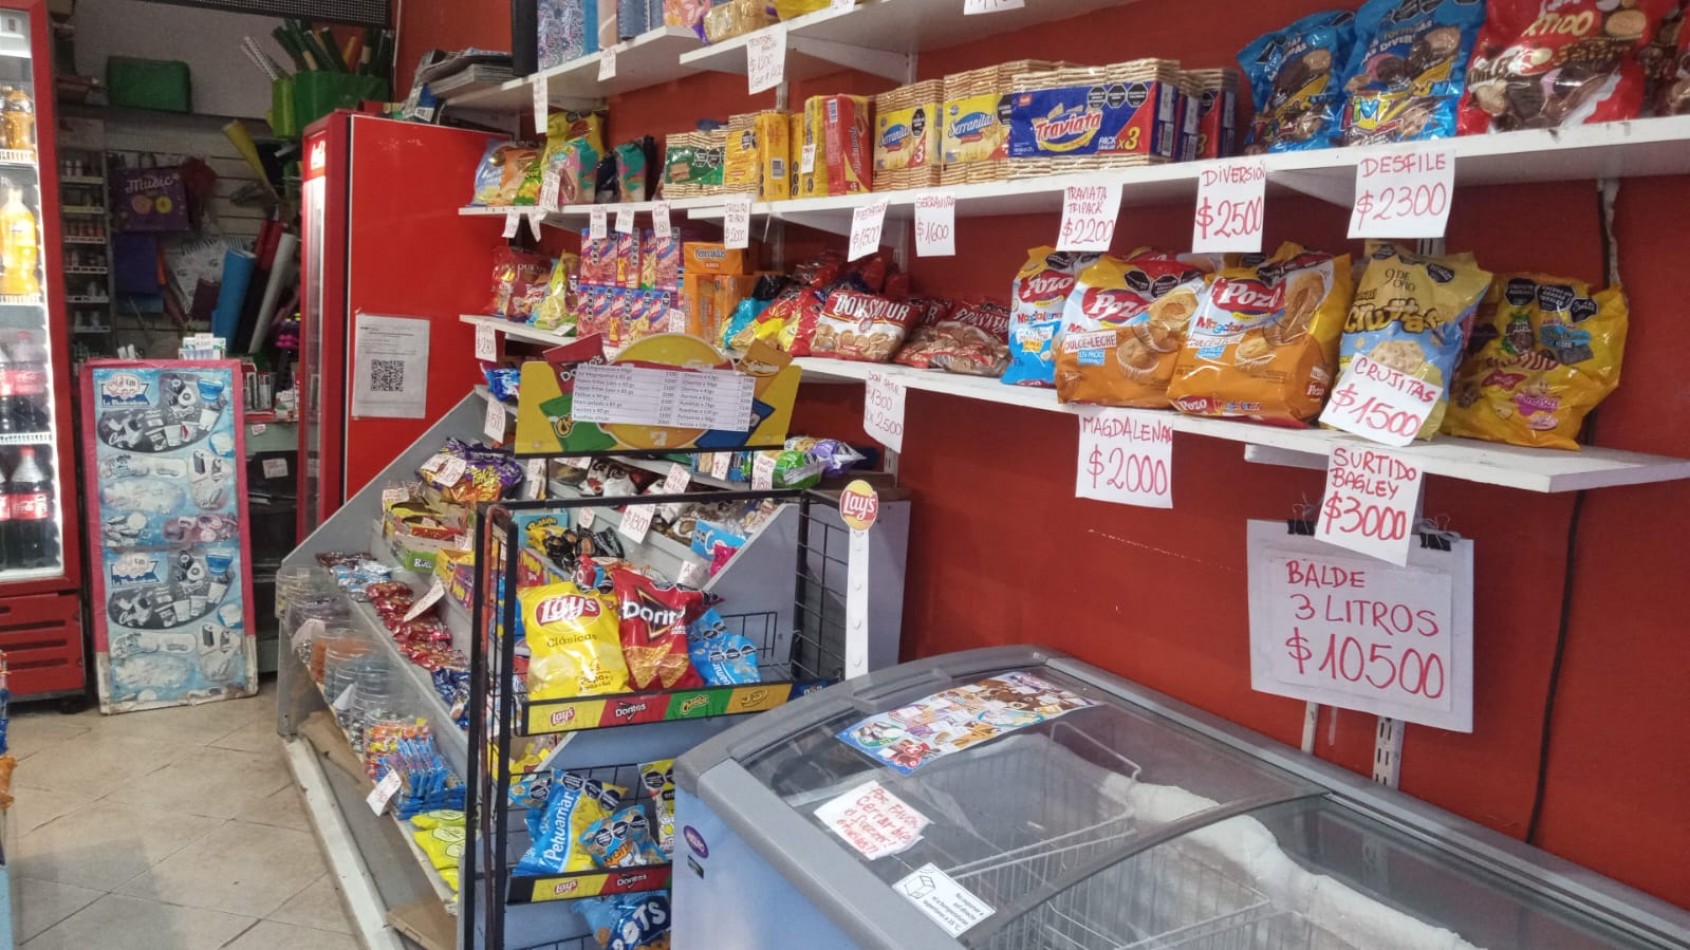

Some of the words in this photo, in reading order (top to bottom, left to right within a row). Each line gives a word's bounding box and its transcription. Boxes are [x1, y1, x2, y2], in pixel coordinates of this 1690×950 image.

[1036, 111, 1101, 141] Traviata
[1362, 153, 1445, 179] DESFILE
[1067, 186, 1108, 200] TRAVIATA
[1356, 182, 1446, 230] $2300
[916, 219, 949, 244] $1600
[1063, 218, 1115, 244] $2200
[1195, 196, 1263, 240] $2500
[1332, 382, 1421, 438] $1500
[1088, 446, 1169, 496] $2000
[1330, 466, 1399, 498] BAGLEY
[1333, 447, 1417, 483] SURTIDO
[1323, 490, 1407, 541] $3000
[1286, 560, 1366, 589] BALDE
[1290, 594, 1315, 621] 3
[1326, 600, 1439, 637] LITROS
[1285, 627, 1445, 699] $10500
[615, 702, 647, 718] Doritos
[547, 791, 575, 862] Pehuamar
